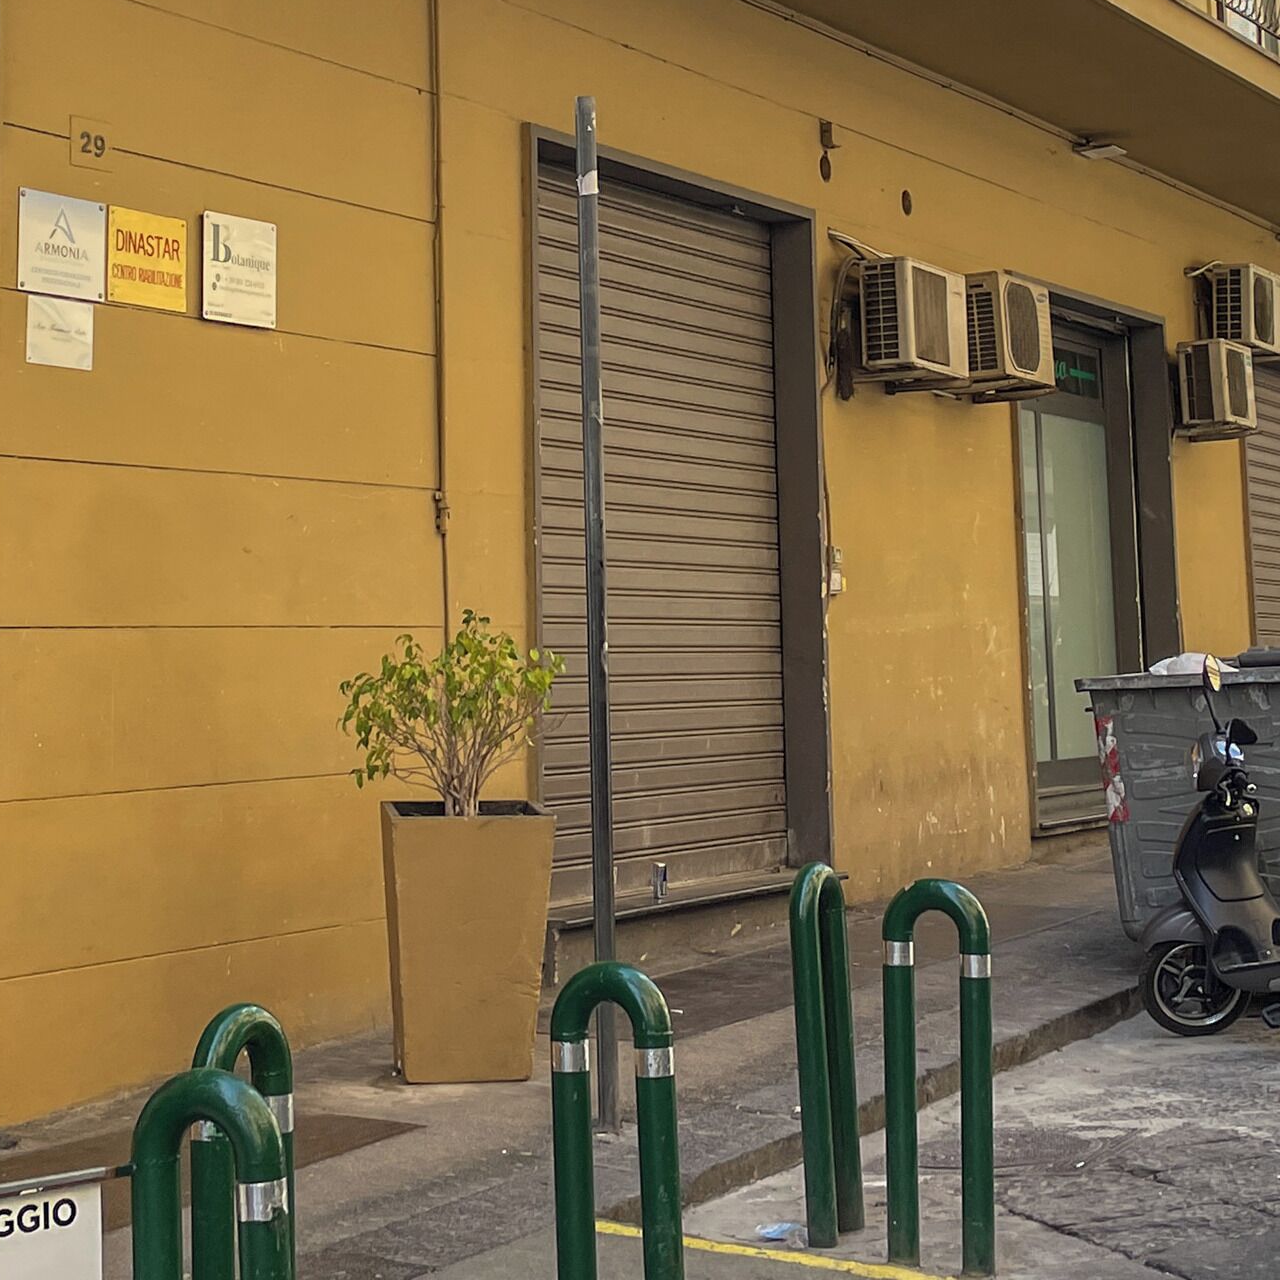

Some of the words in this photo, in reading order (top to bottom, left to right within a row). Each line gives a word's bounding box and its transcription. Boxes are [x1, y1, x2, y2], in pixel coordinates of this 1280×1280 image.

[80, 130, 106, 158] 29
[34, 241, 89, 261] ARMONIA
[115, 228, 181, 262] DINASTAR
[210, 222, 271, 272] Botanique
[111, 263, 137, 281] CENTRO
